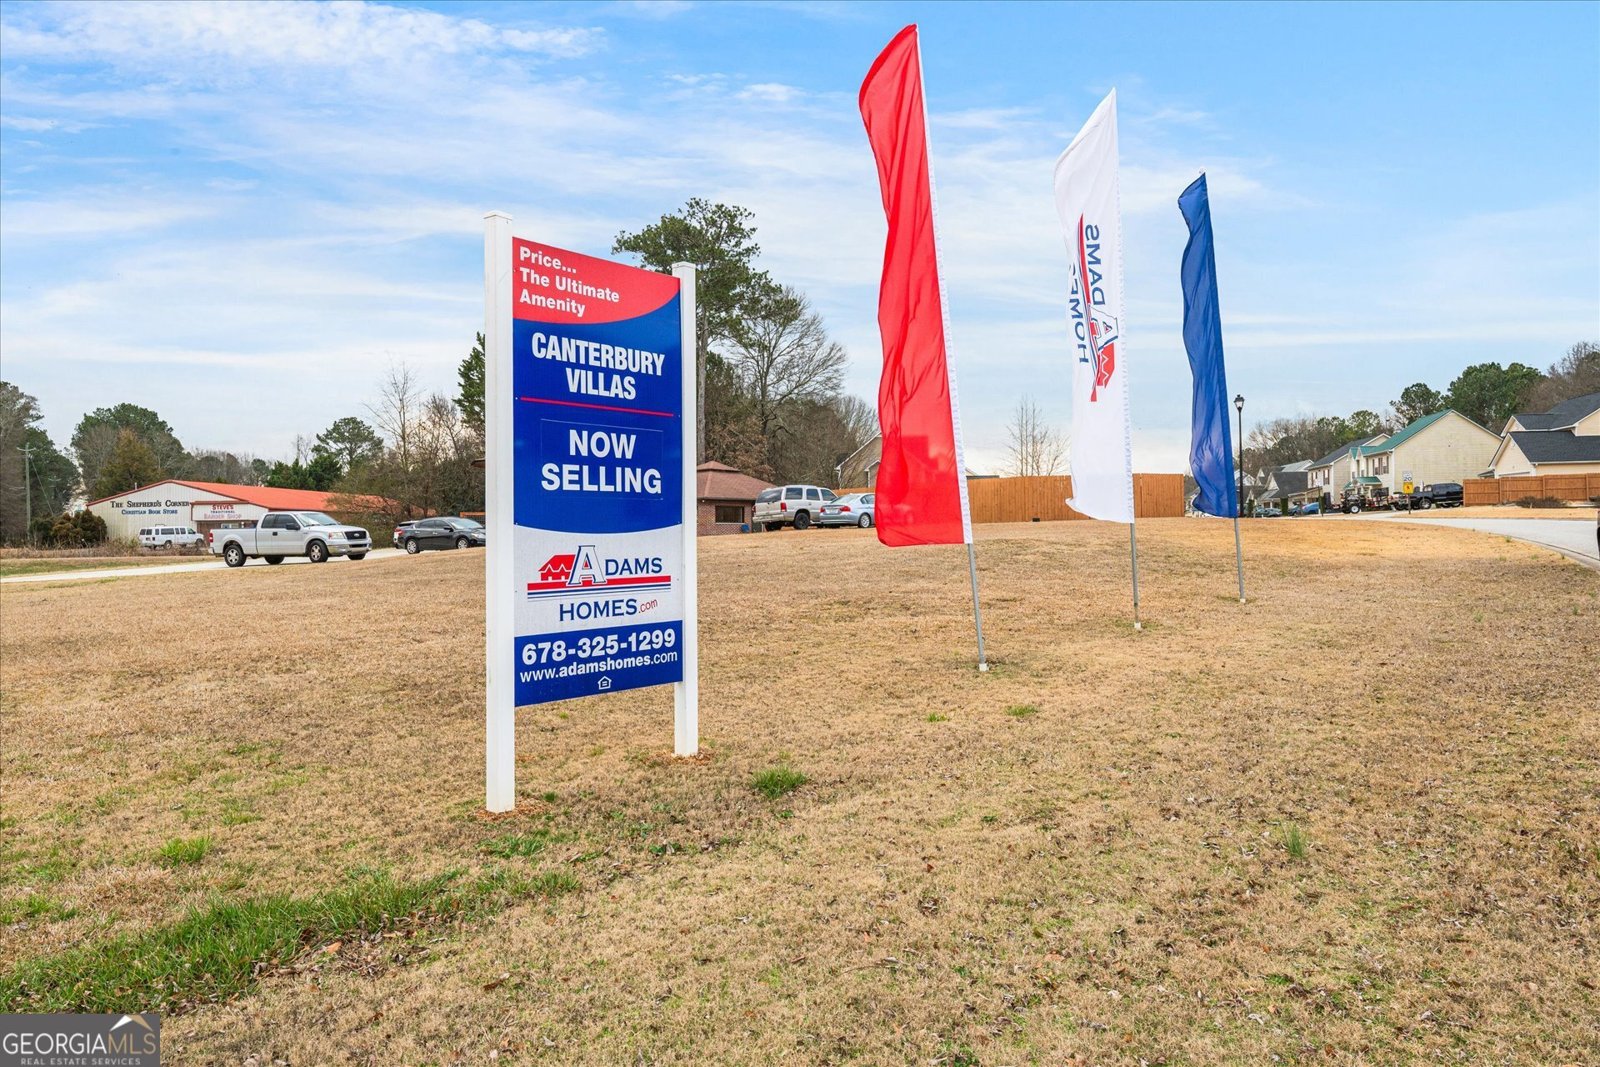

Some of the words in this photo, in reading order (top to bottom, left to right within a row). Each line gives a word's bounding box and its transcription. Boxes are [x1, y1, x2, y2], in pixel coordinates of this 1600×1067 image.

[520, 246, 577, 274] Price...
[520, 268, 550, 286] The
[556, 275, 620, 302] Ultimate
[520, 289, 586, 318] Amenity
[532, 332, 666, 376] CANTERBURY
[566, 368, 636, 400] VILLAS
[569, 429, 636, 460] NOW
[541, 462, 662, 494] SELLING
[567, 544, 662, 585] ADAMS
[522, 628, 676, 665] 678-325-1299
[520, 651, 678, 682] www.adamshomes.com
